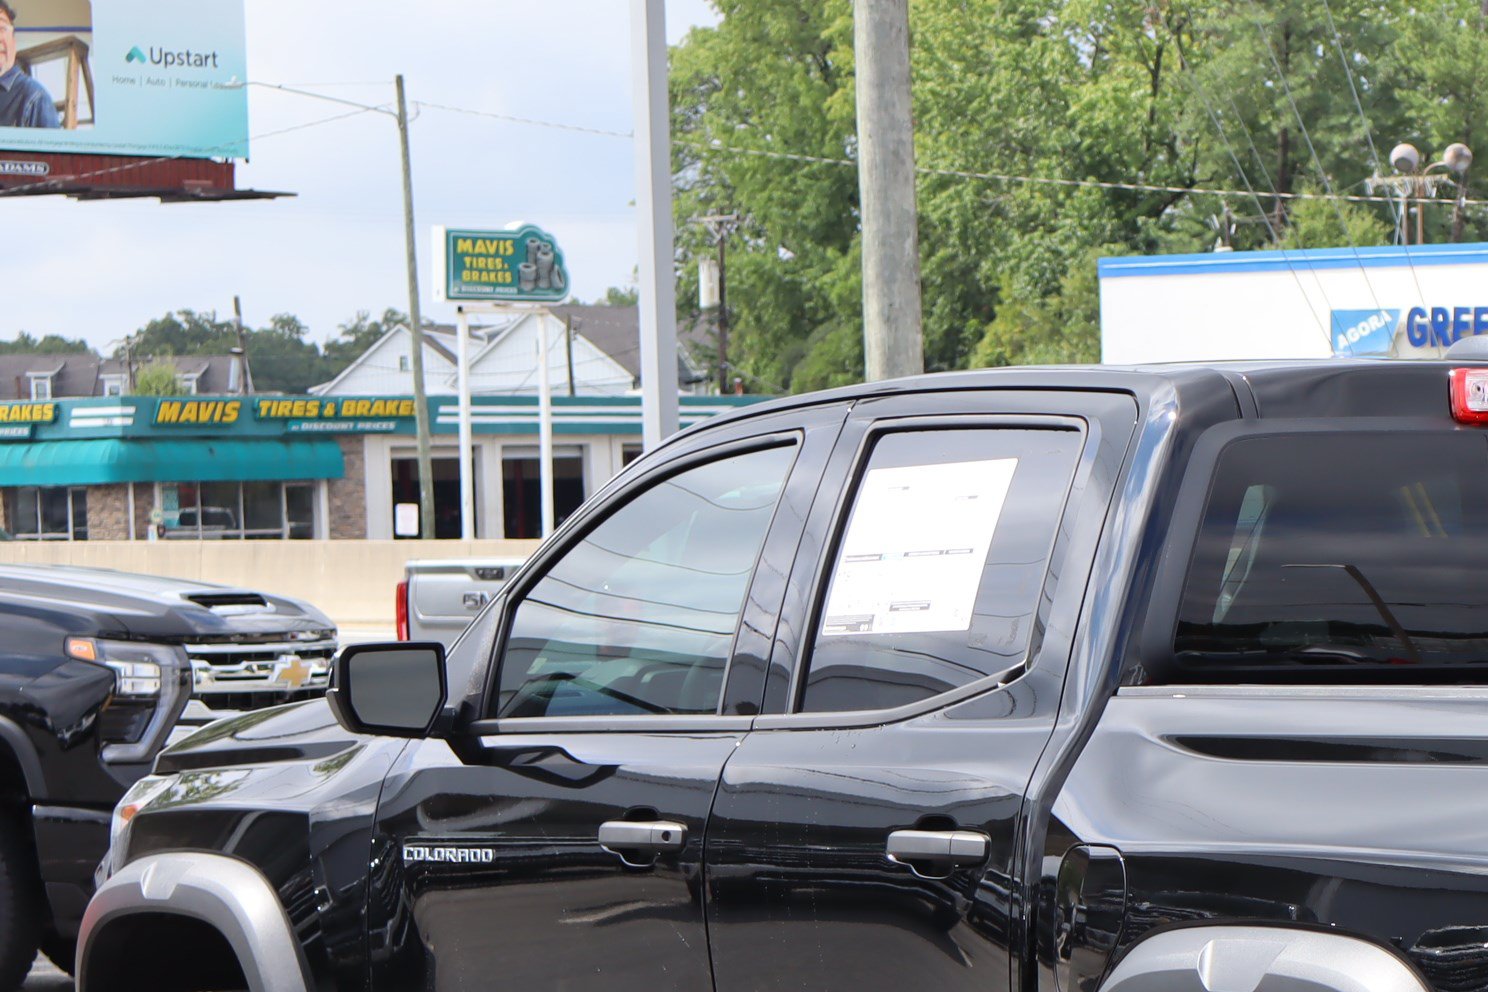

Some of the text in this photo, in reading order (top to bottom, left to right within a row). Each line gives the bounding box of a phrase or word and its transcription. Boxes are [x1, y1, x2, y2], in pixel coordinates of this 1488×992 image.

[150, 46, 219, 69] Upstart
[111, 75, 136, 86] Home
[146, 77, 166, 88] Auto
[175, 78, 208, 89] Personal
[456, 238, 514, 256] MAVIS
[463, 256, 503, 270] TIRES
[462, 270, 513, 283] BRAKES
[1336, 309, 1393, 351] AGORA
[157, 399, 417, 423] MAVIS TIRES & BRAKE
[301, 421, 354, 431] DISCOUNT
[357, 421, 396, 430] PRICES
[403, 847, 493, 862] COLORADO
